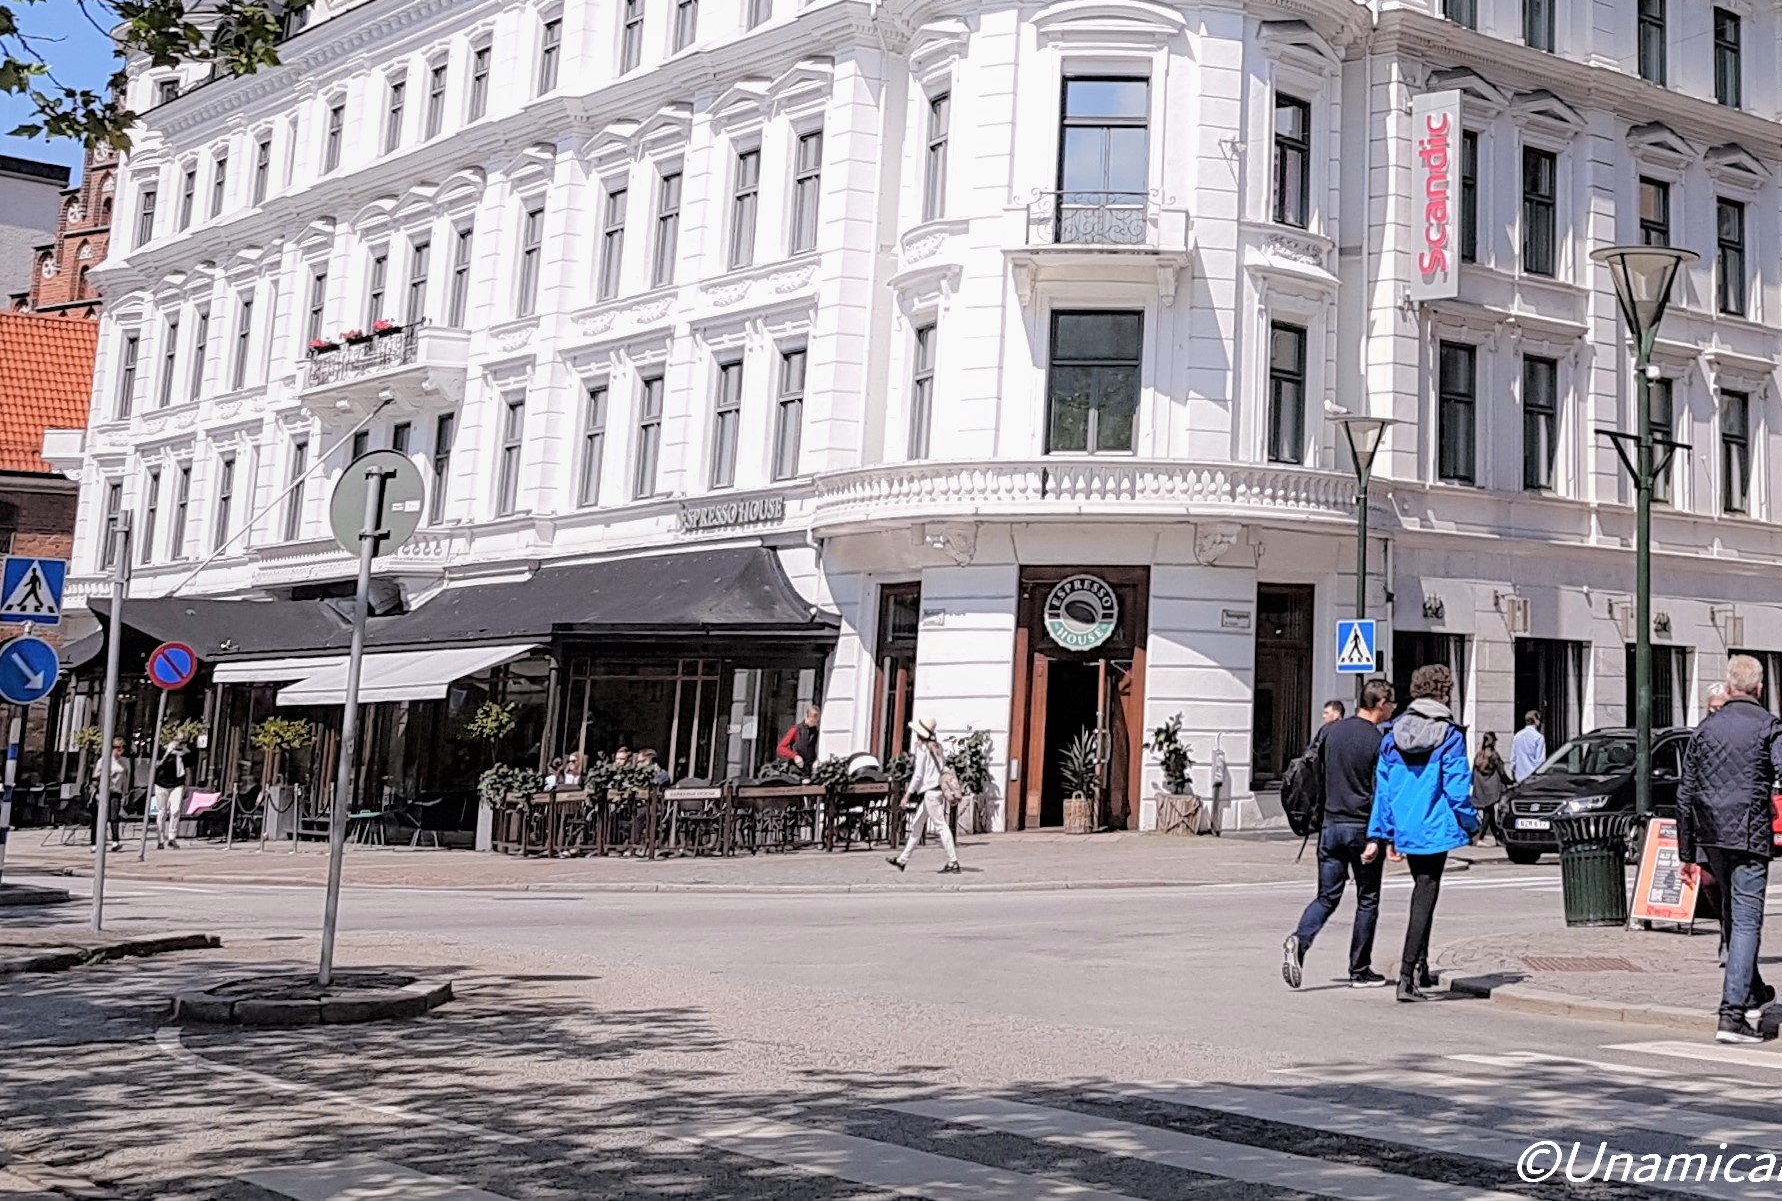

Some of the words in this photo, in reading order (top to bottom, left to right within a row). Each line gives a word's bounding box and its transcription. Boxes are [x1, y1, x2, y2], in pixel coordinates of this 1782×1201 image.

[1419, 113, 1449, 276] Scandic
[681, 503, 737, 528] ESPRESSO
[739, 497, 783, 522] HOUSE
[1051, 579, 1112, 607] ESPRESSO
[1056, 627, 1104, 646] HOUSE
